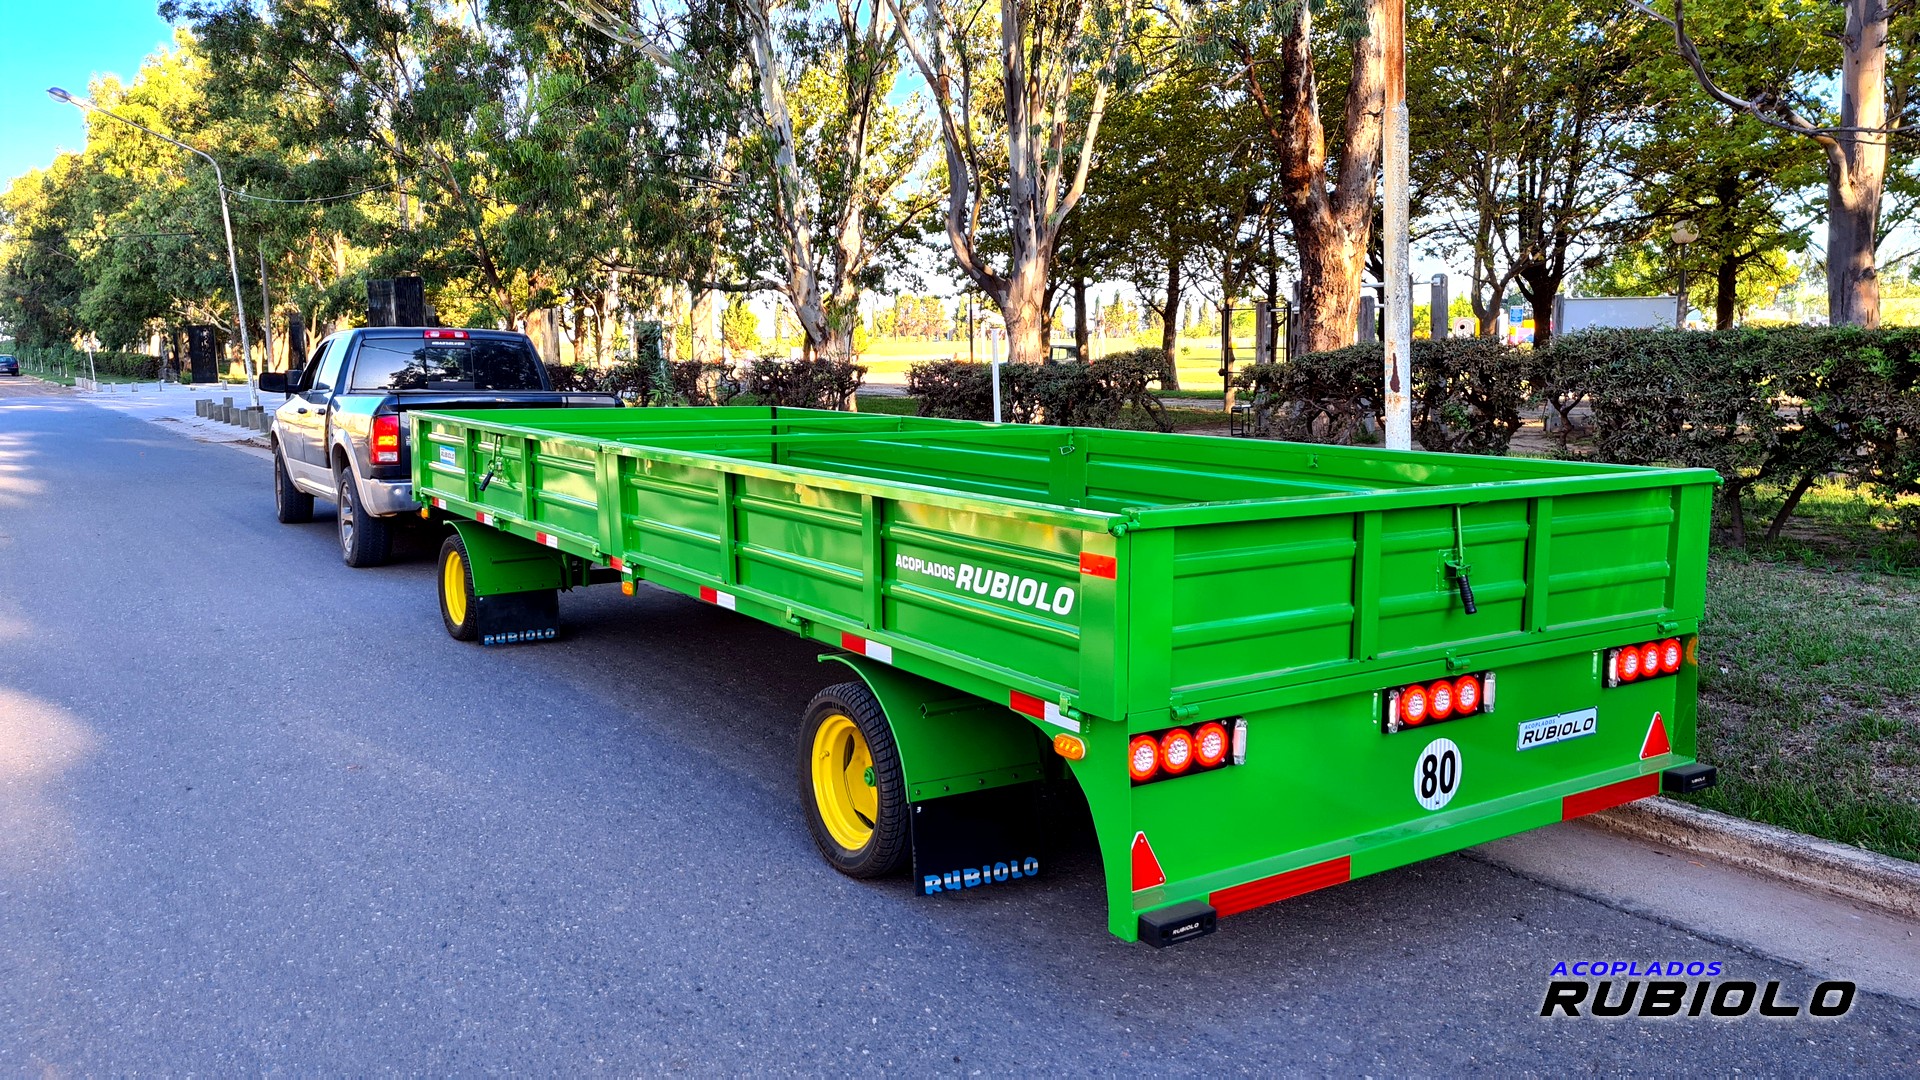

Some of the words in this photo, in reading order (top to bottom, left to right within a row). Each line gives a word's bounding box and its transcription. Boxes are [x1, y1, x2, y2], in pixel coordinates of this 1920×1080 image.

[895, 553, 956, 581] ACOPLADOS
[955, 563, 1075, 615] RUBIOLO
[483, 628, 556, 647] RUBIOLO
[1522, 717, 1594, 745] RUBIOLO
[1524, 718, 1556, 731] ACOPLADOS
[1421, 750, 1456, 799] 80
[924, 856, 1039, 895] RUBIOLO
[1172, 922, 1200, 935] RUBIOLO
